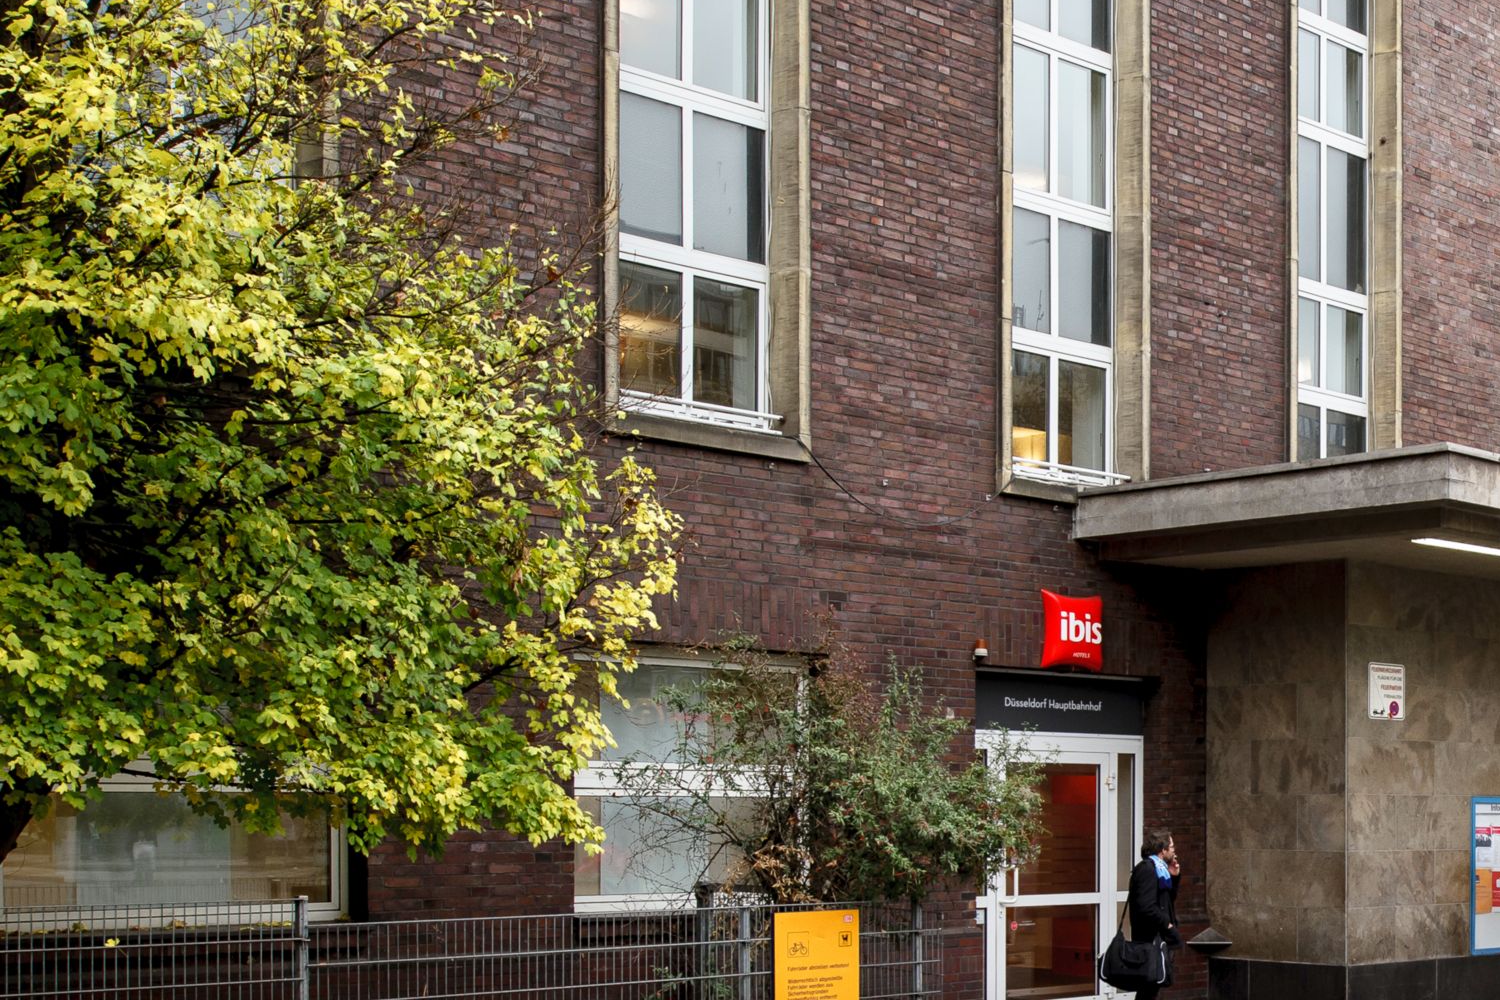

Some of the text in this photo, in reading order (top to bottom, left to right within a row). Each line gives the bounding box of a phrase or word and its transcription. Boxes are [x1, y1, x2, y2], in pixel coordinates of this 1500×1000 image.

[1060, 610, 1103, 645] ibis
[1004, 696, 1102, 712] Düsseldorf Hauptbahnhof
